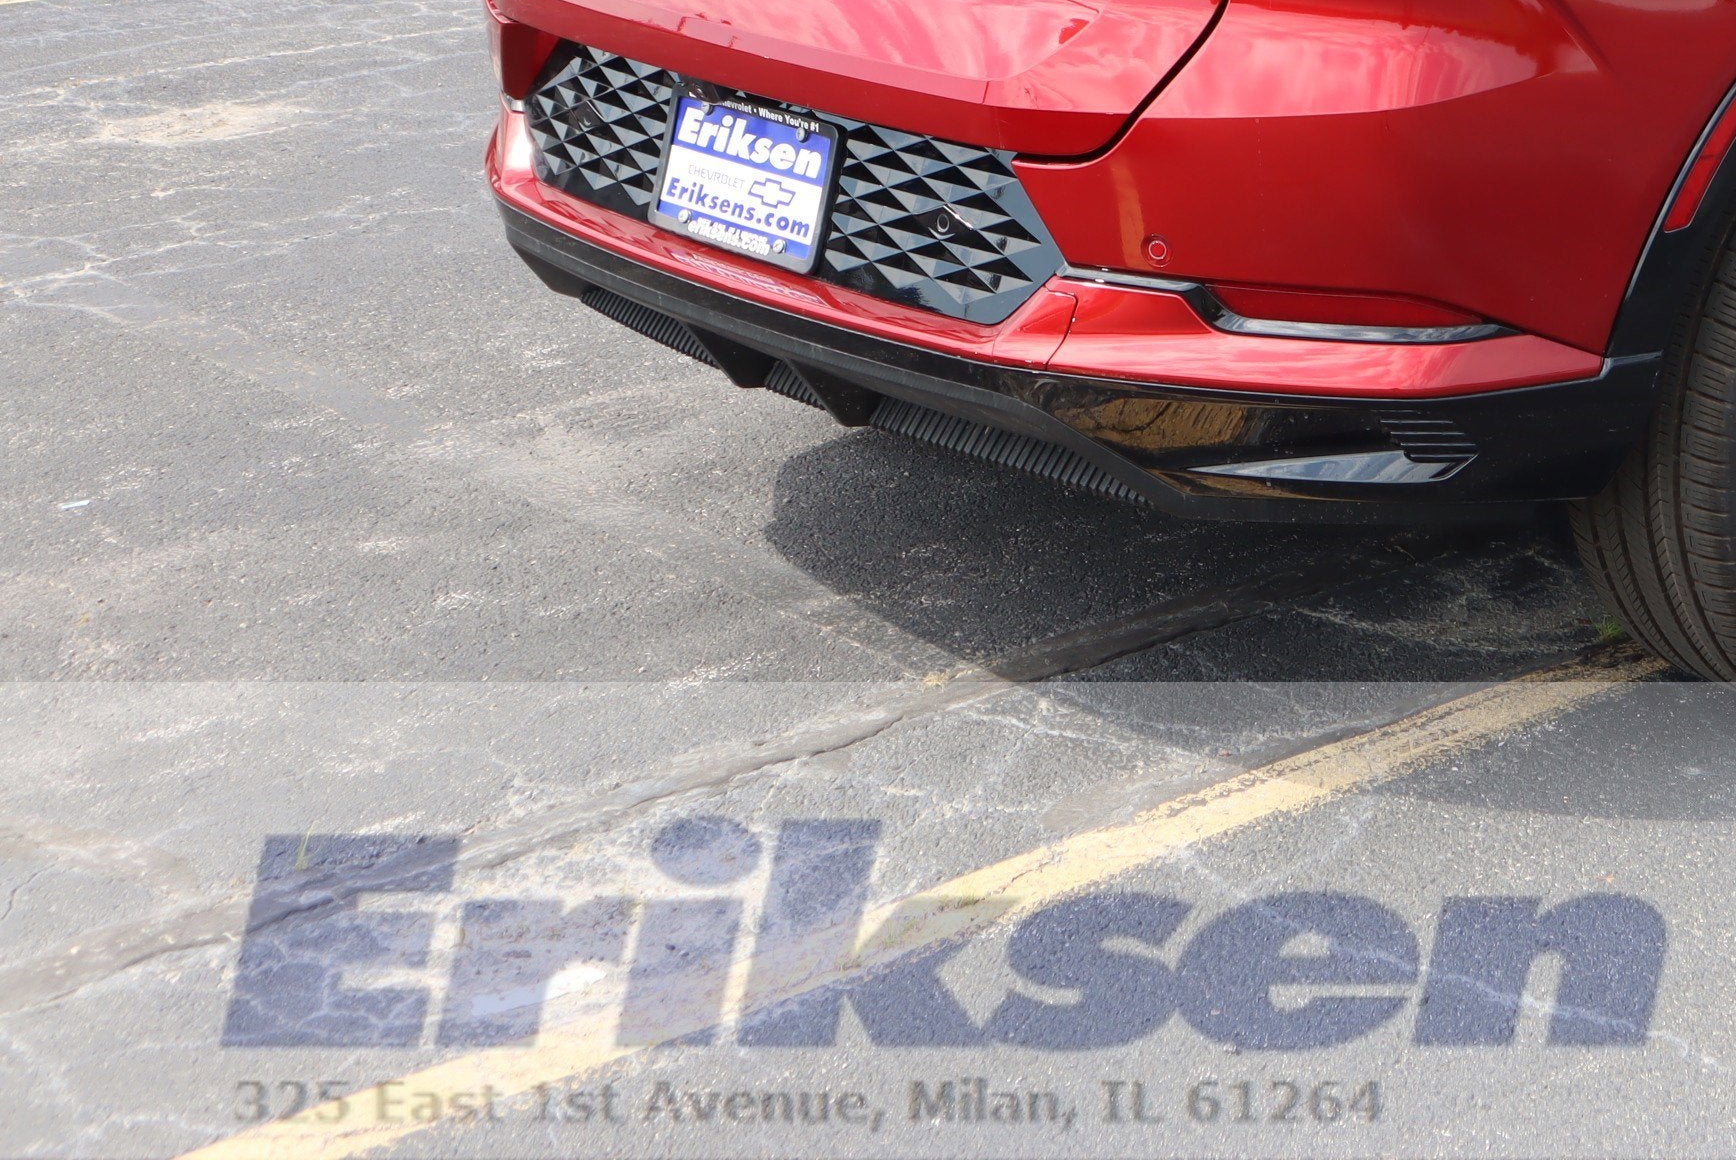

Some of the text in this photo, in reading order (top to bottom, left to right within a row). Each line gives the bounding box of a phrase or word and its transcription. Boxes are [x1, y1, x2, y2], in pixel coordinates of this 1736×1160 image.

[758, 106, 783, 124] Where
[784, 114, 810, 130] You're
[810, 122, 820, 133] #1
[678, 106, 823, 179] Eriksen
[688, 163, 746, 190] CHEVROLET
[666, 177, 811, 239] Eriksens.com
